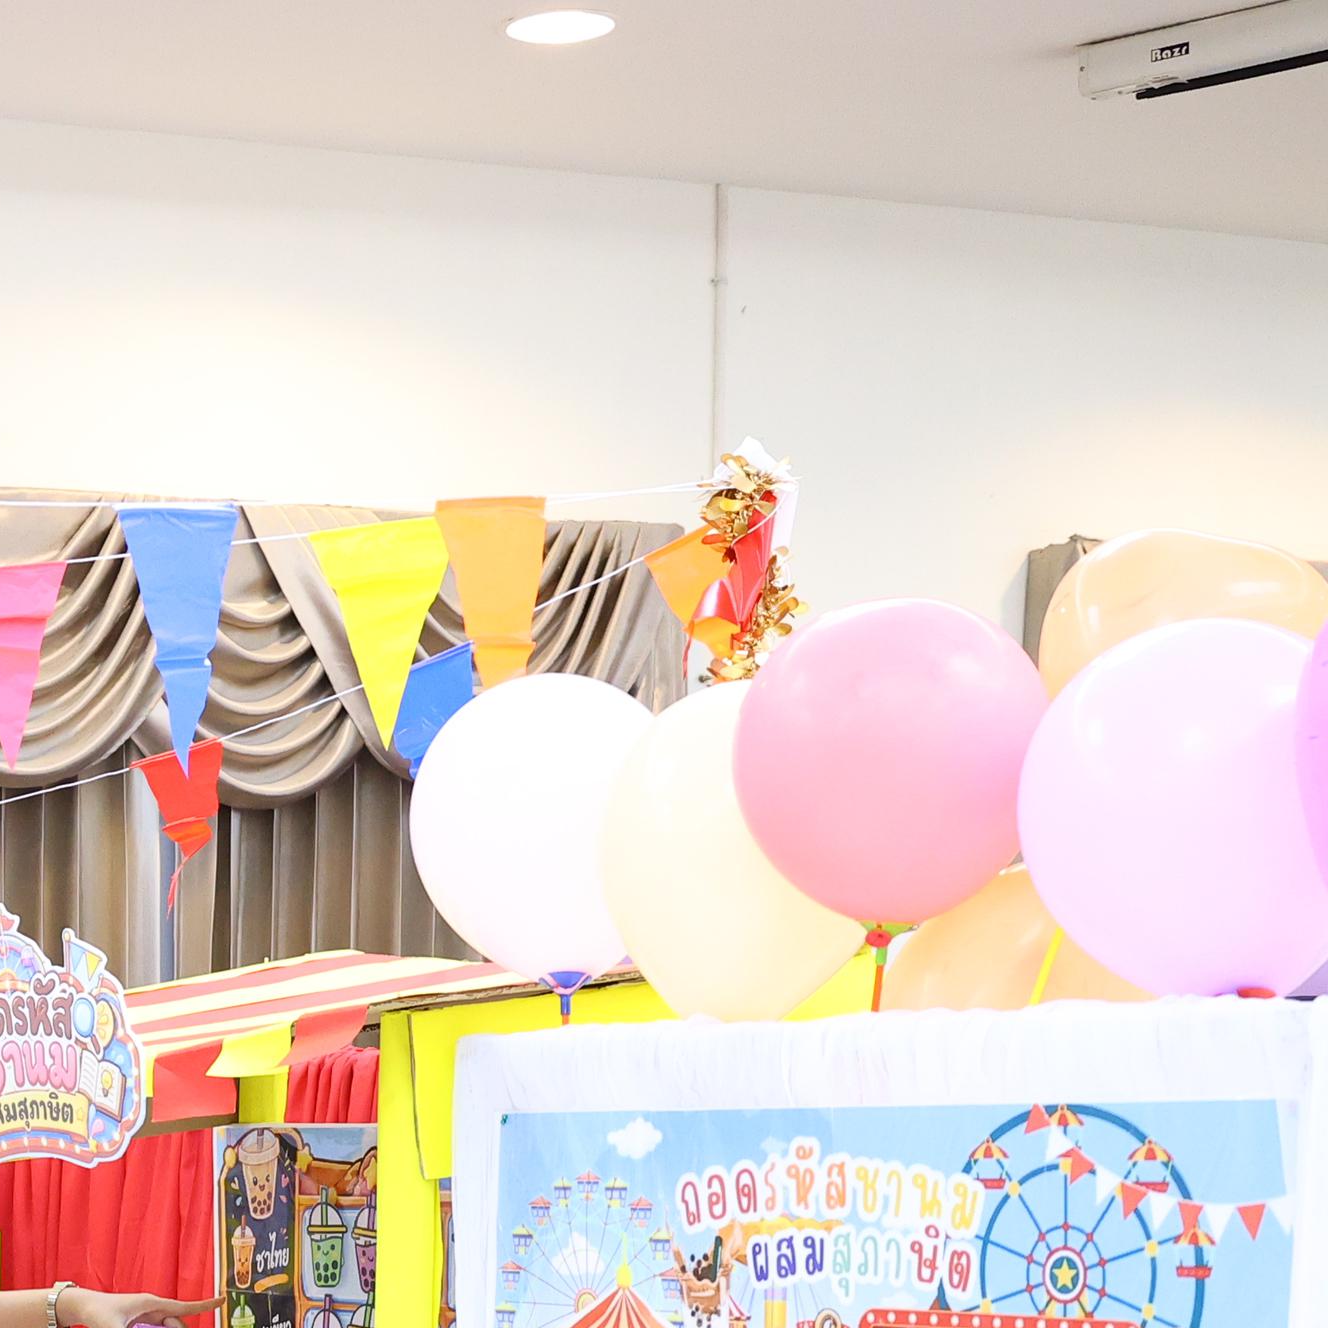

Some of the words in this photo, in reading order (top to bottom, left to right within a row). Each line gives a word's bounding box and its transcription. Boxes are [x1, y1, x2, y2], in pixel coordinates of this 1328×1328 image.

[1153, 44, 1188, 62] Razr
[681, 1144, 981, 1231] ถอดรหัสชานม
[256, 1231, 290, 1273] ชาไทย
[751, 1225, 974, 1296] ผสมสุภาษิต
